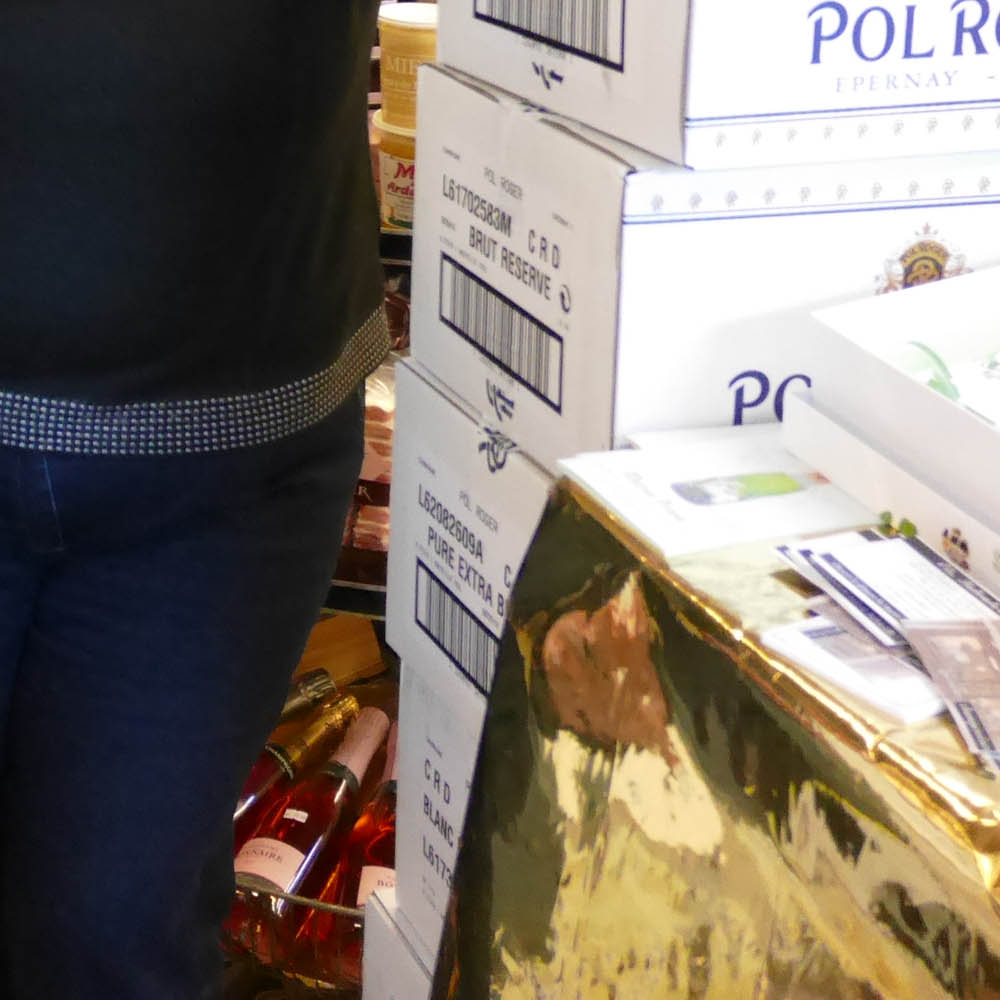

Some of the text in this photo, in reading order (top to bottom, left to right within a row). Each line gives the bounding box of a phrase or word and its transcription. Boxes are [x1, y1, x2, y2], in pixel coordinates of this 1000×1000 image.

[806, 0, 936, 65] POL
[835, 69, 959, 94] EPERNAY
[442, 173, 512, 238] L61702583M
[469, 224, 551, 301] BRUT RESERVE
[418, 483, 484, 565] L62082609A
[427, 525, 456, 570] PURE
[458, 555, 493, 608] EXTRA
[423, 794, 454, 849] BLANC
